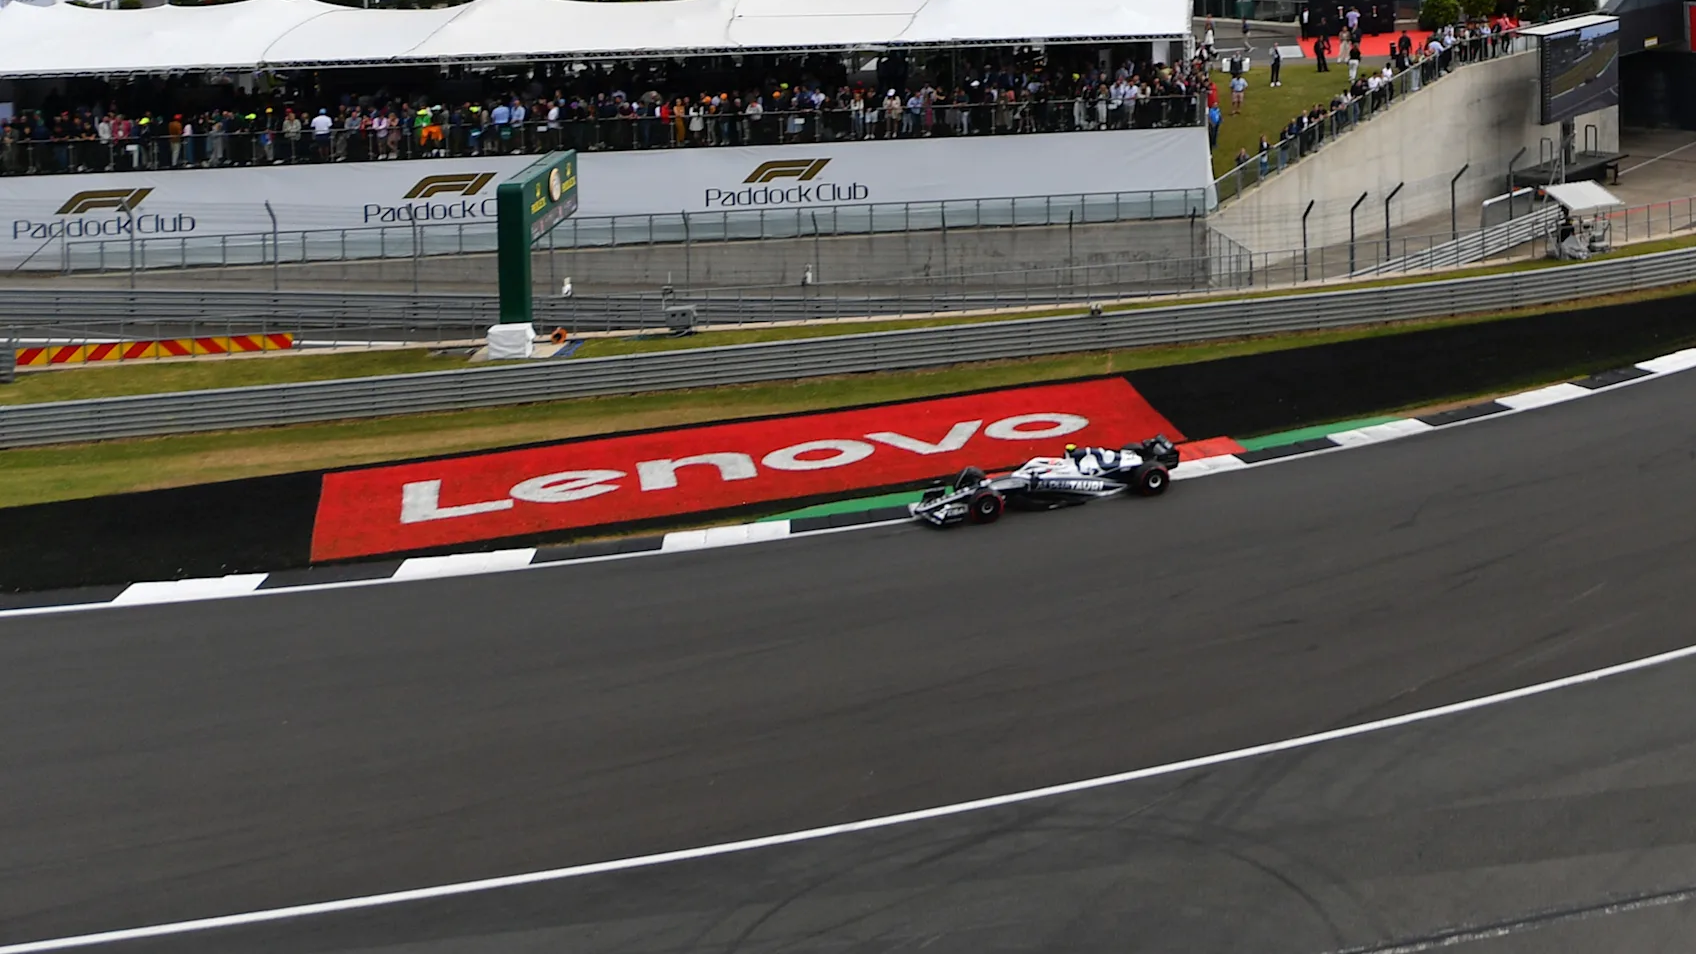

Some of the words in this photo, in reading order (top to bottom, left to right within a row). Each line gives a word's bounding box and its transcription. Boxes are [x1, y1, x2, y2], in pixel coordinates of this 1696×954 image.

[705, 185, 812, 207] Paddock
[817, 182, 869, 202] Club
[364, 199, 476, 223] Paddock
[12, 215, 132, 239] Paddock
[136, 213, 196, 234] Club
[401, 412, 1090, 524] Lenovo
